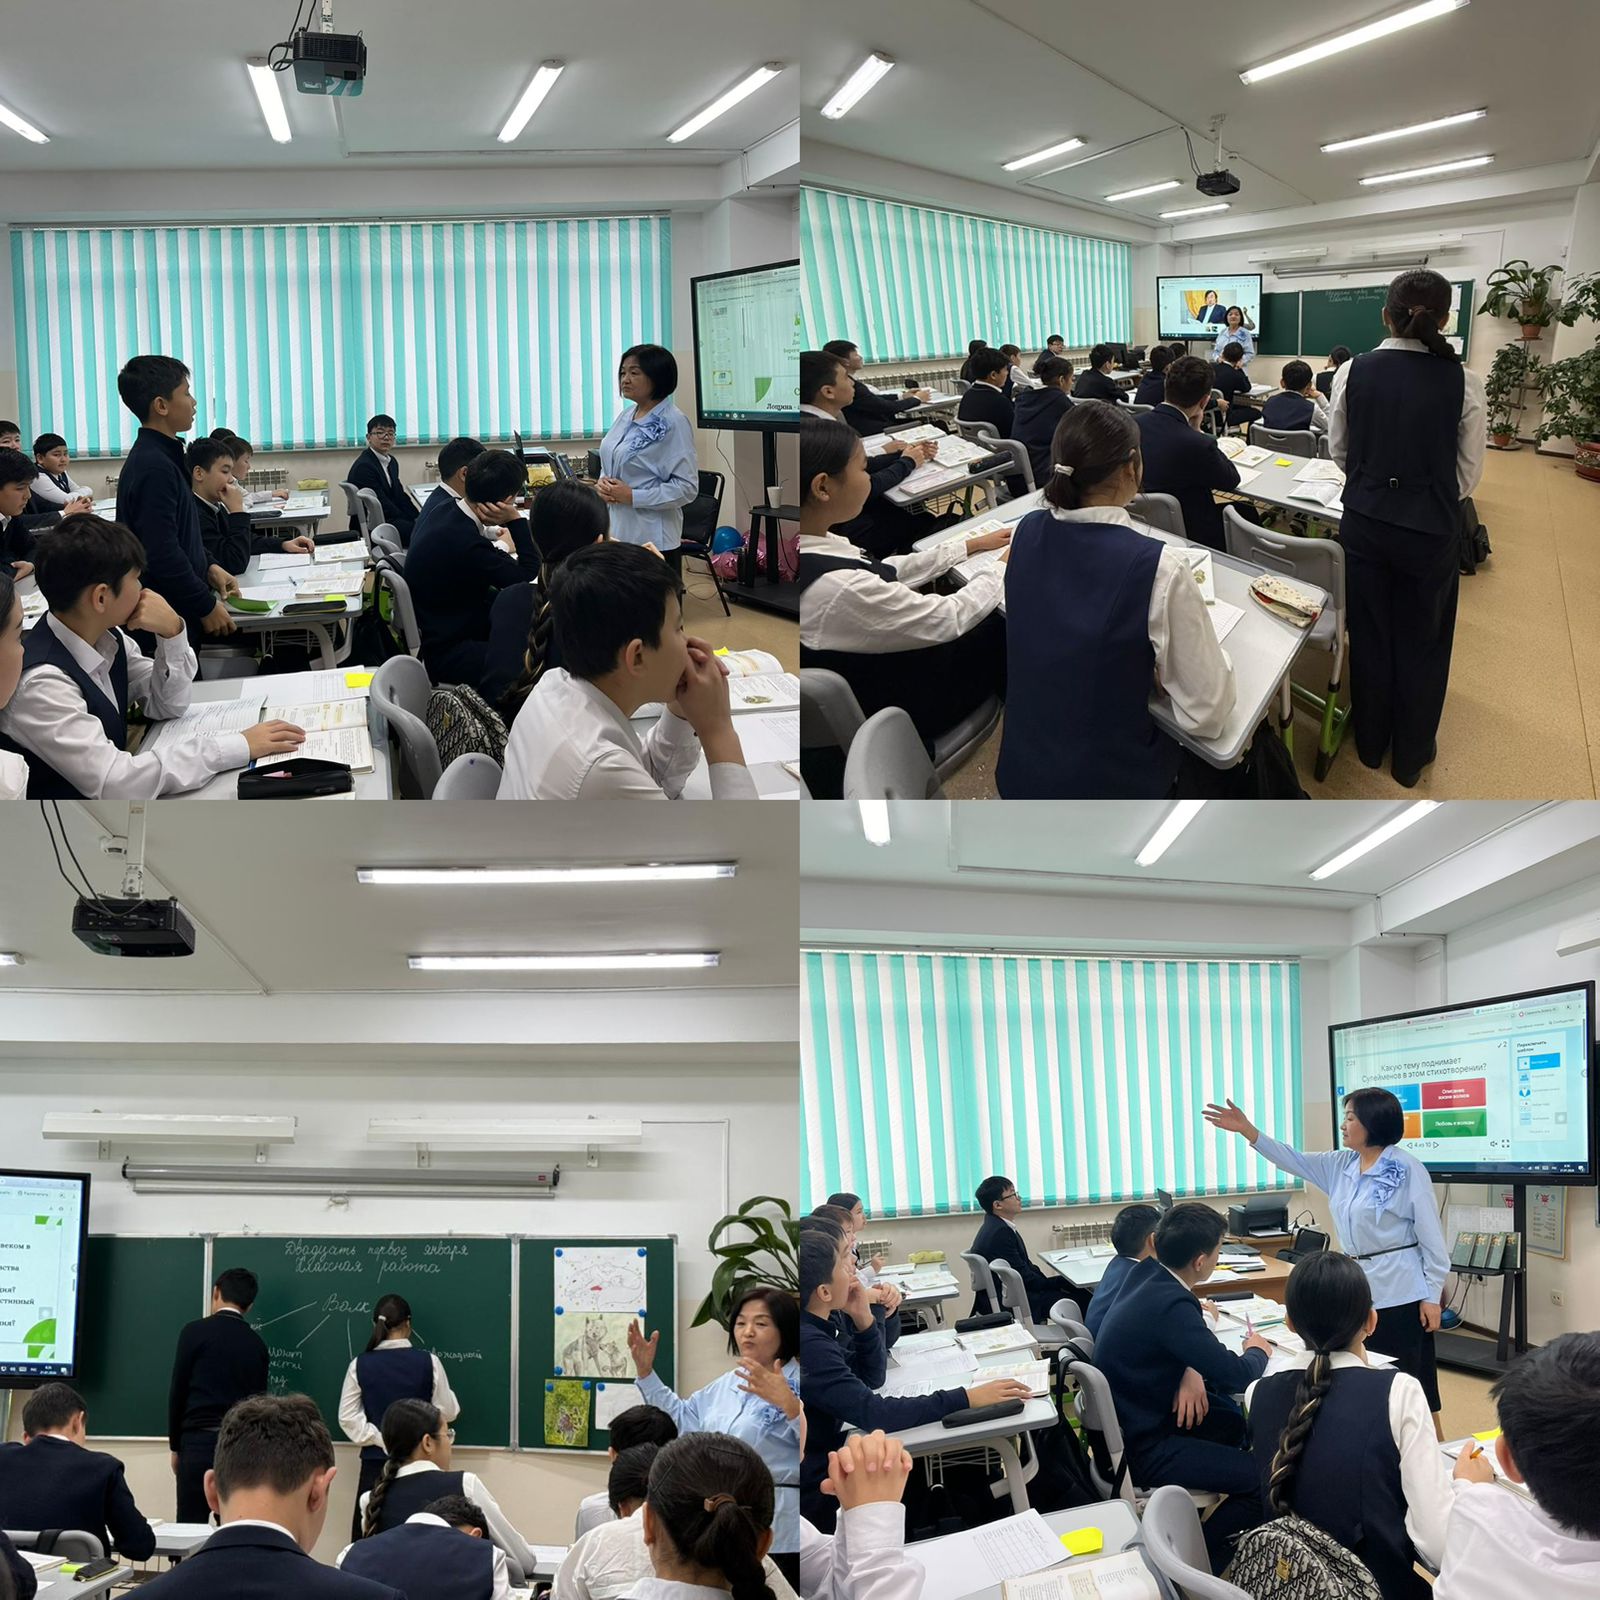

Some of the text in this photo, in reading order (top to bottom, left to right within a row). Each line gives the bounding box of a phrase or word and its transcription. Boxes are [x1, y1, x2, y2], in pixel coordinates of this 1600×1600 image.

[1381, 1057, 1462, 1072] Какую тему поднимает
[1408, 1070, 1426, 1078] этом
[1426, 1062, 1488, 1076] стихотворении?
[284, 1240, 469, 1264] Двадцать первое января
[295, 1256, 441, 1284] Классная работа
[322, 1292, 372, 1314] Волк
